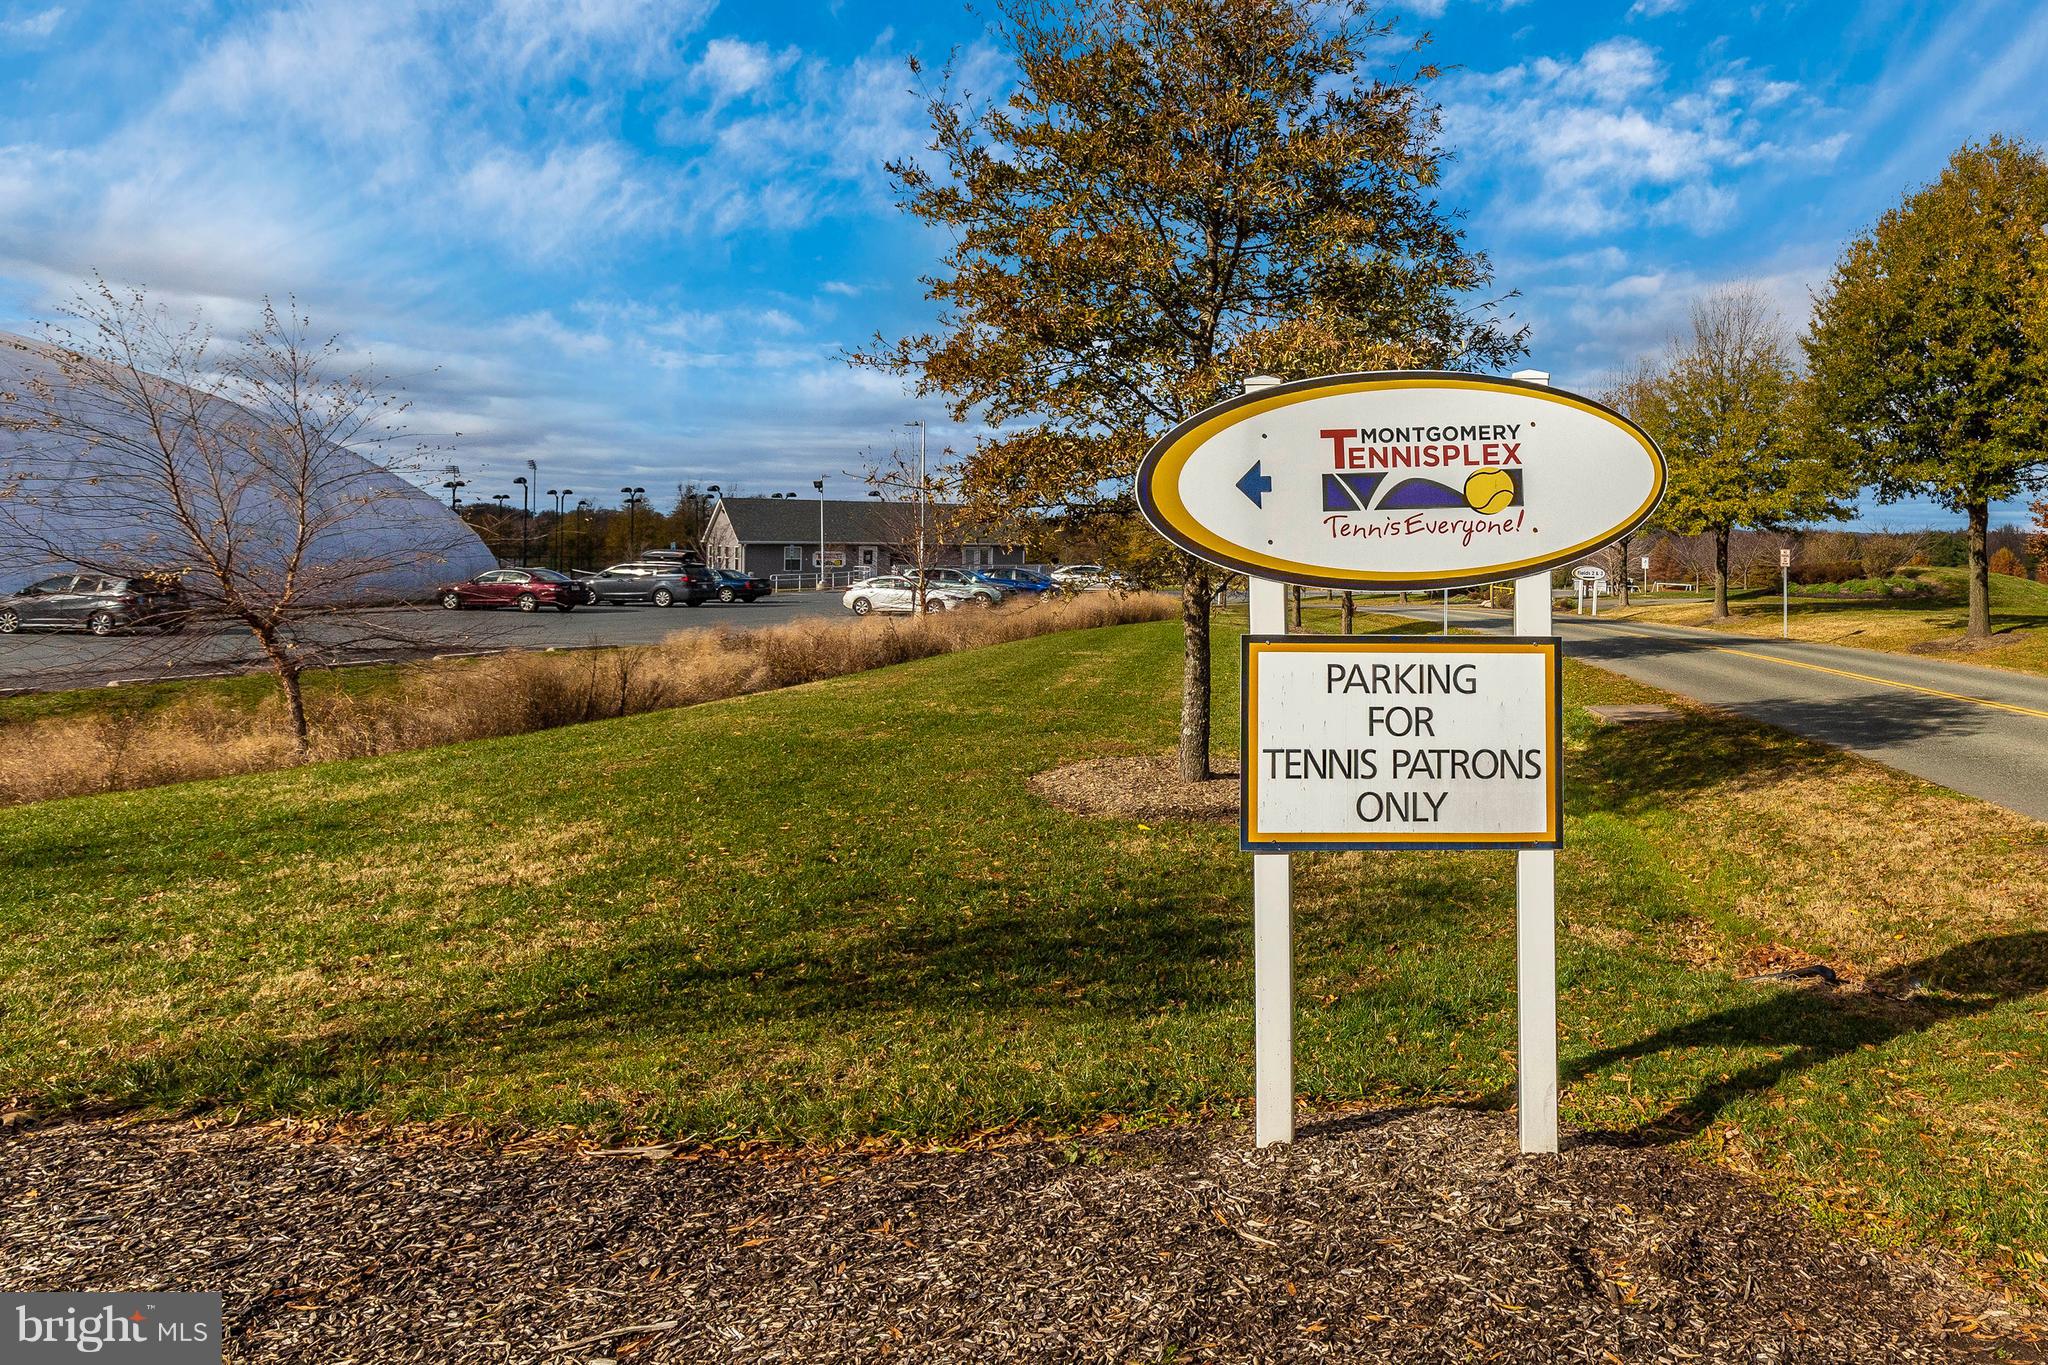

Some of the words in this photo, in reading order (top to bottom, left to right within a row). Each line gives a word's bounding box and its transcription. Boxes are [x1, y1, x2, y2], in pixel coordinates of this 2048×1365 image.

[1319, 428, 1524, 470] TENNISPLEX
[1360, 423, 1521, 445] MONTGOMERY
[1327, 663, 1478, 695] PARKING
[1368, 706, 1436, 738] FOR
[1262, 748, 1378, 780] TENNIS
[1392, 748, 1542, 780] PATRONS
[1355, 791, 1449, 823] ONLY
